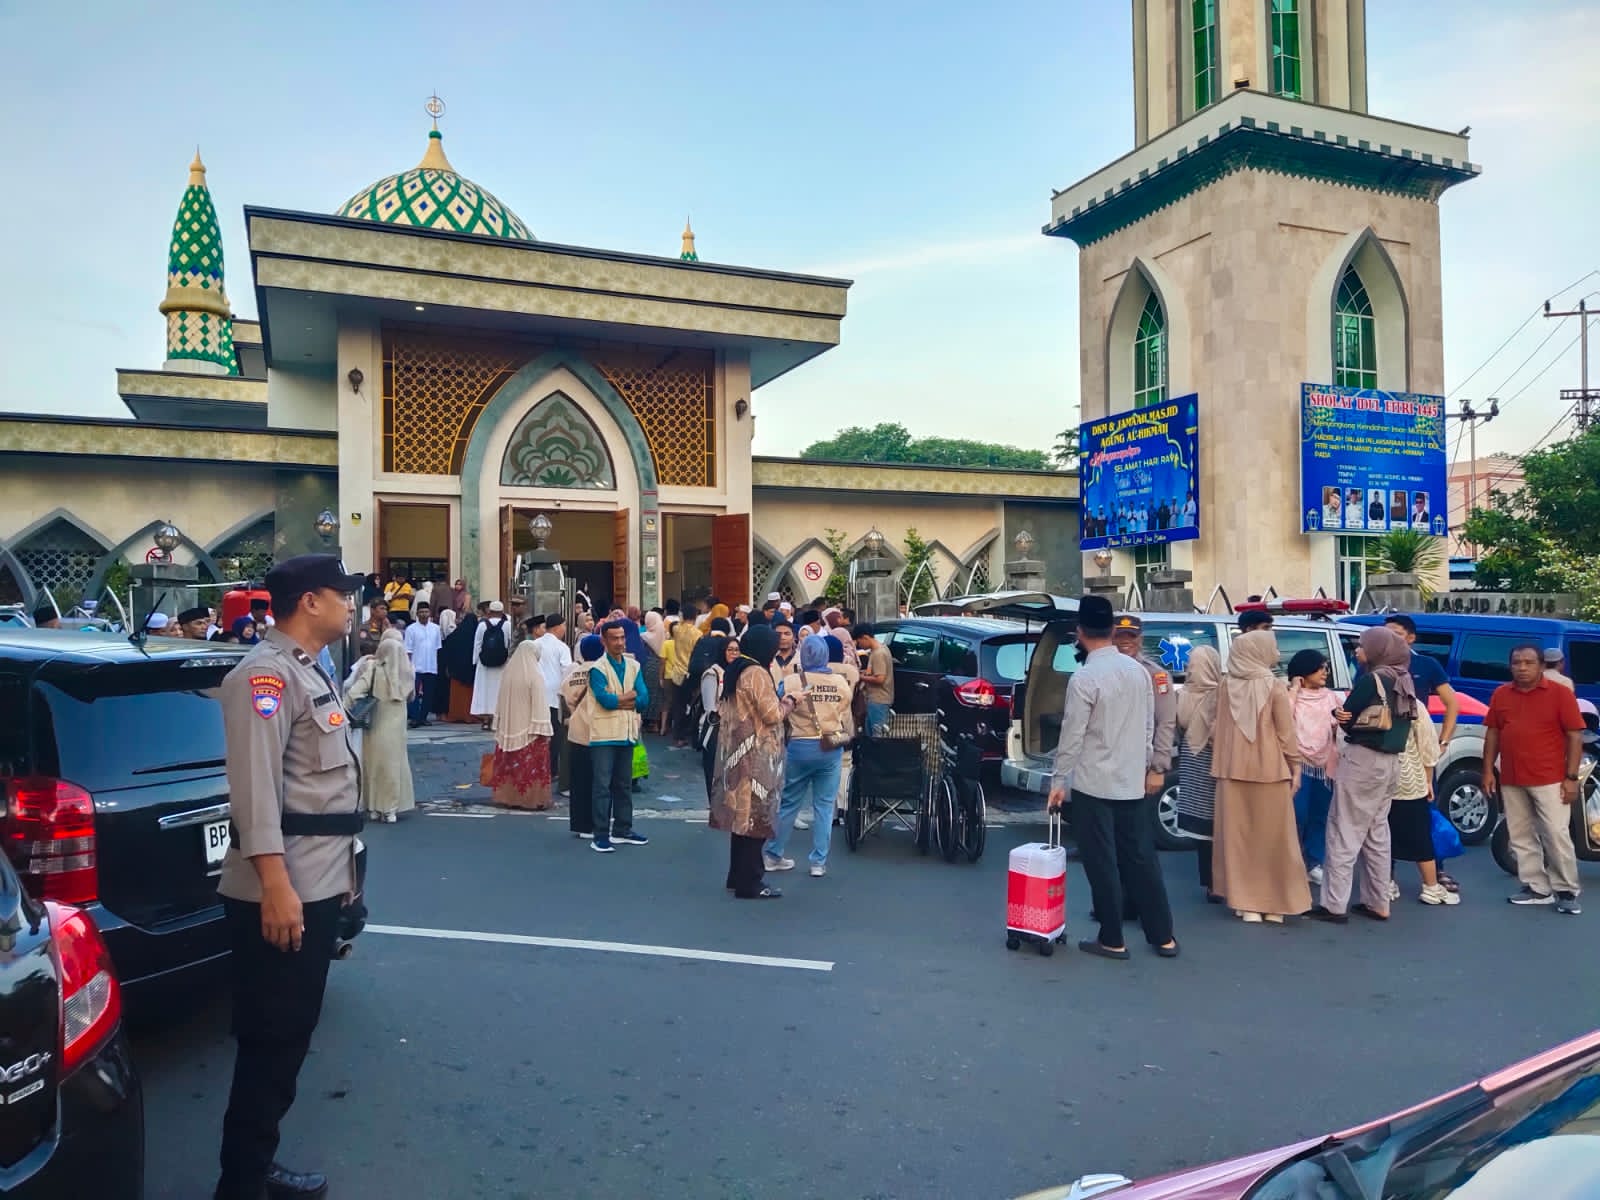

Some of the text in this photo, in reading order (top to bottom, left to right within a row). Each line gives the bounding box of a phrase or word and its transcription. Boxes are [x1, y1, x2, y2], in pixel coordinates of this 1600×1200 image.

[1310, 393, 1438, 417] SHOLAT IDUL FITRI 1445
[1091, 423, 1108, 436] DKM
[1149, 405, 1178, 419] MASJID
[1101, 436, 1125, 449] AGUNG
[1114, 462, 1142, 472] SELAMAT
[1144, 456, 1160, 467] HARI
[1424, 597, 1556, 613] MASJID AGUNG
[209, 825, 227, 848] BP
